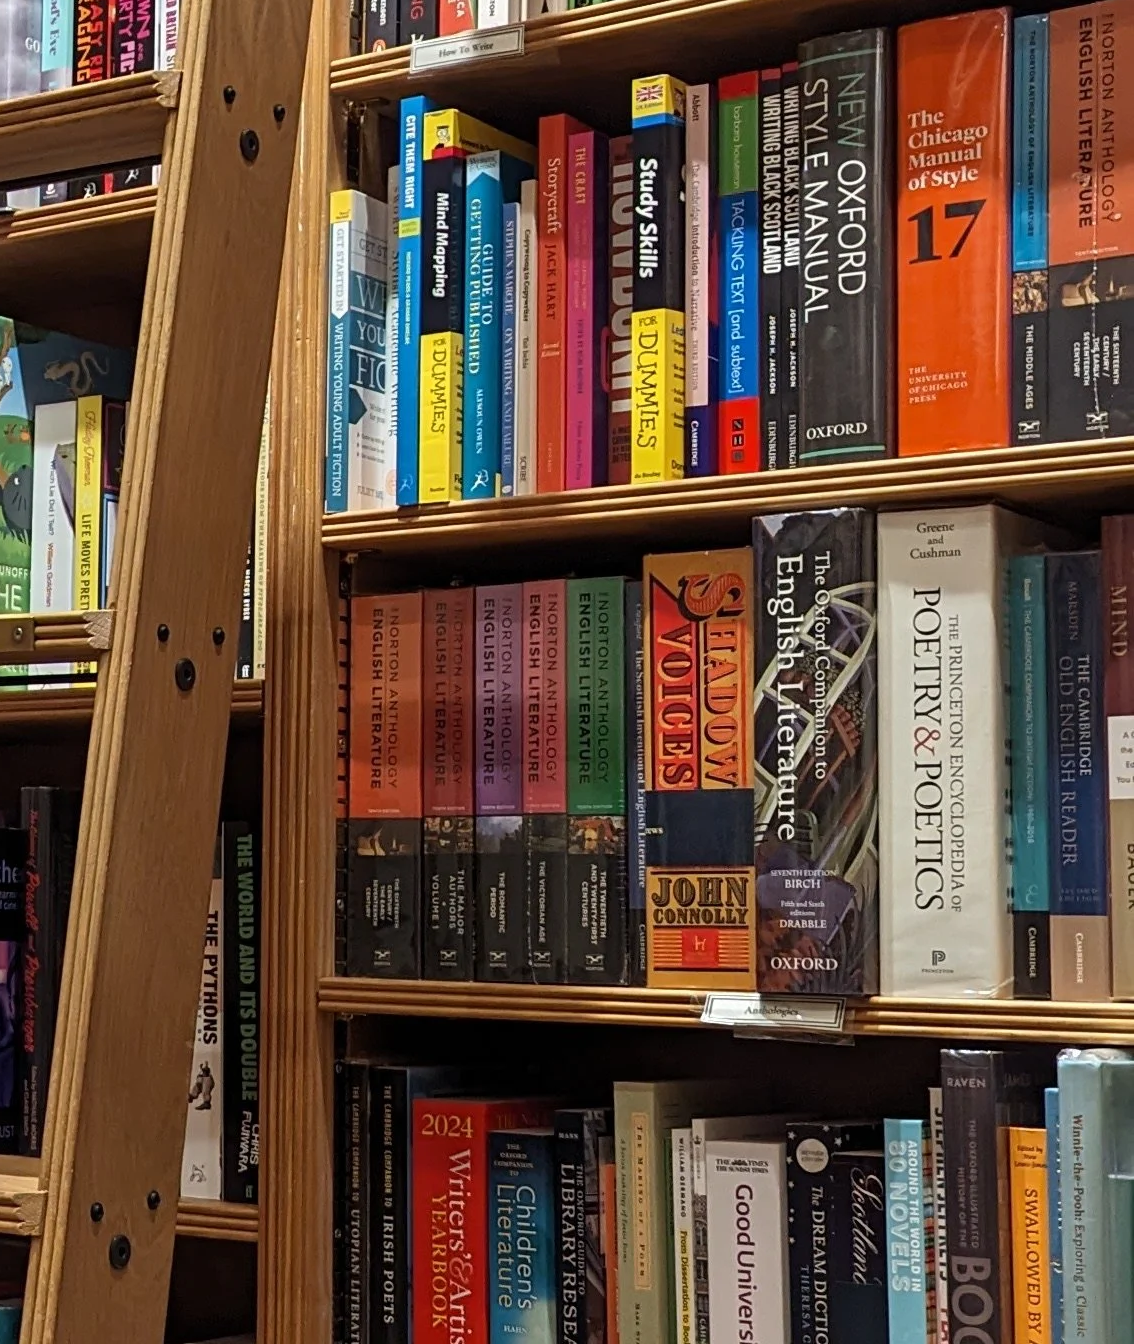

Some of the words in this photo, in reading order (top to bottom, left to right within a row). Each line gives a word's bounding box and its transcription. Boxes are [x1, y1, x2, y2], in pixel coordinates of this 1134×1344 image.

[804, 77, 829, 172] STYLE
[837, 73, 866, 148] NEW
[908, 110, 944, 129] The
[908, 122, 988, 150] Chicago
[908, 144, 982, 170] Manual
[908, 172, 928, 191] of
[930, 166, 979, 189] Style
[635, 157, 658, 220] Study
[638, 224, 655, 280] Skills
[803, 176, 829, 324] MANUAL
[837, 159, 867, 297] OXFORD
[907, 198, 987, 265] 17
[635, 329, 658, 450] DUMMIES
[806, 422, 868, 441] OXFORD
[909, 546, 961, 560] Cushman
[916, 521, 955, 535] Greene
[766, 555, 805, 676] English
[912, 586, 942, 728] POETRY
[776, 682, 805, 841] Literature
[914, 726, 942, 756] &
[914, 762, 944, 912] POETICS
[651, 877, 748, 907] JOHN
[784, 878, 821, 890] BIRCH
[652, 906, 748, 926] CONNOLLY
[778, 918, 827, 930] DRABBLE
[770, 957, 838, 972] OXFORD
[420, 1113, 473, 1139] 2024
[734, 1183, 755, 1239] Good
[431, 1195, 449, 1330] YEARBOOK
[496, 1184, 515, 1307] Literature
